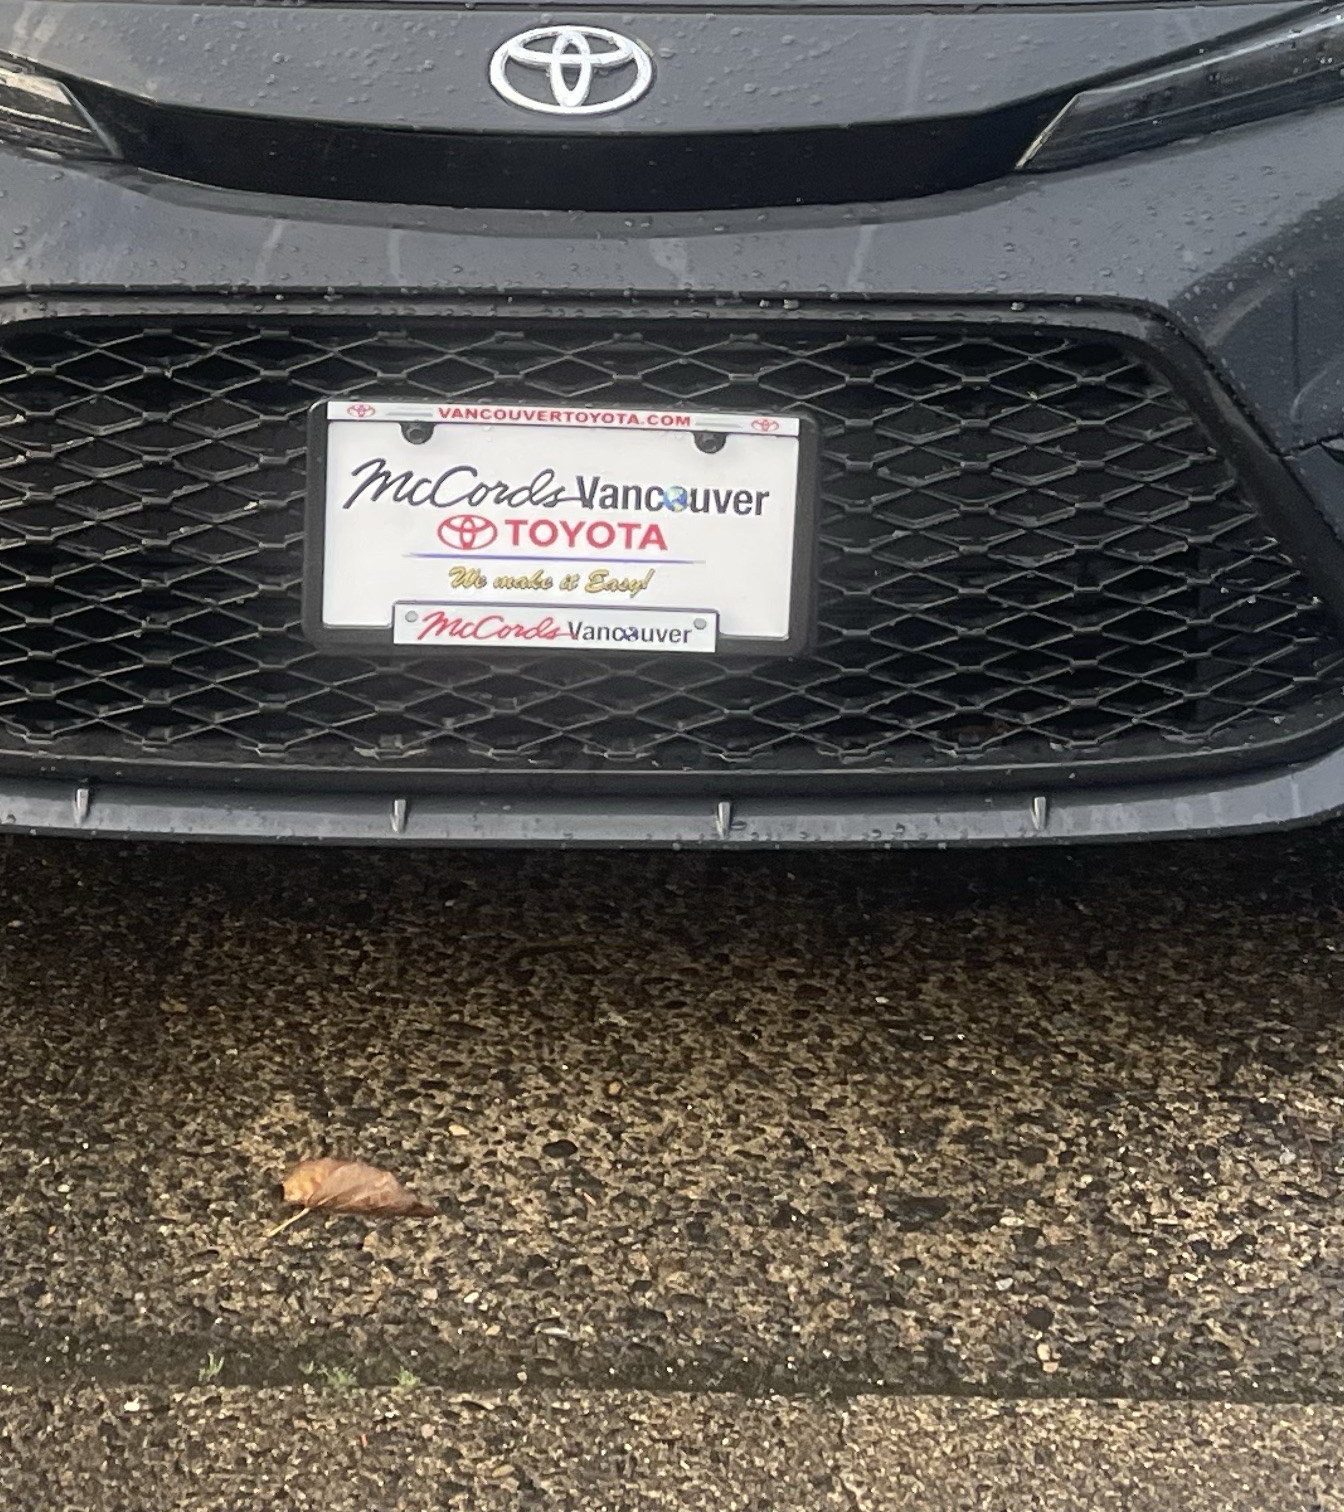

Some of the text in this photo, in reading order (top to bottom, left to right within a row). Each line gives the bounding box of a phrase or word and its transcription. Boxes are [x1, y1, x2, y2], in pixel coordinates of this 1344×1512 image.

[438, 406, 692, 428] VANCOUVERTOYOTA.COM
[342, 457, 770, 517] McCords Vancouver
[504, 518, 668, 552] TOYOTA
[447, 566, 656, 599] We make it Easy!
[416, 610, 694, 646] McCords Vancouver
